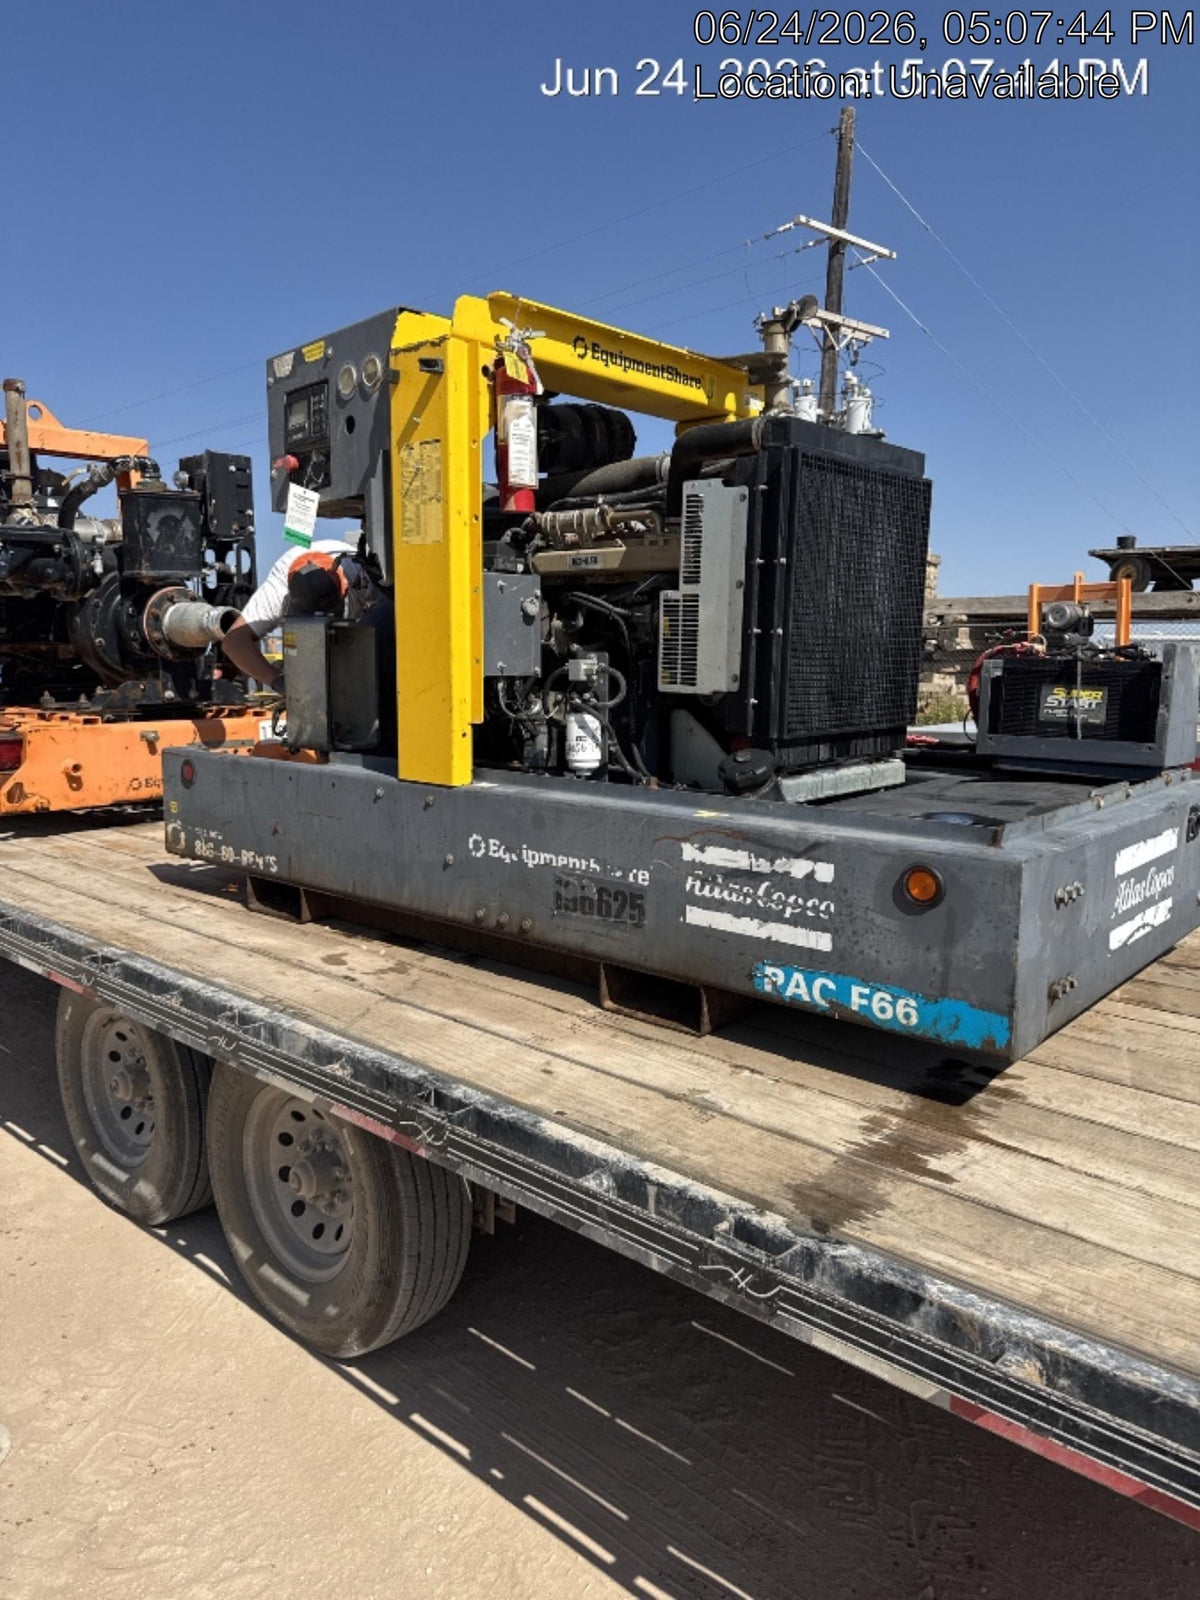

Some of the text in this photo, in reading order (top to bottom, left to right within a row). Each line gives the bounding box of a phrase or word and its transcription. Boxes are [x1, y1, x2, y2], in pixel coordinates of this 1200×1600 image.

[591, 342, 702, 390] EquipmentShare
[764, 965, 920, 1027] PAC F66
